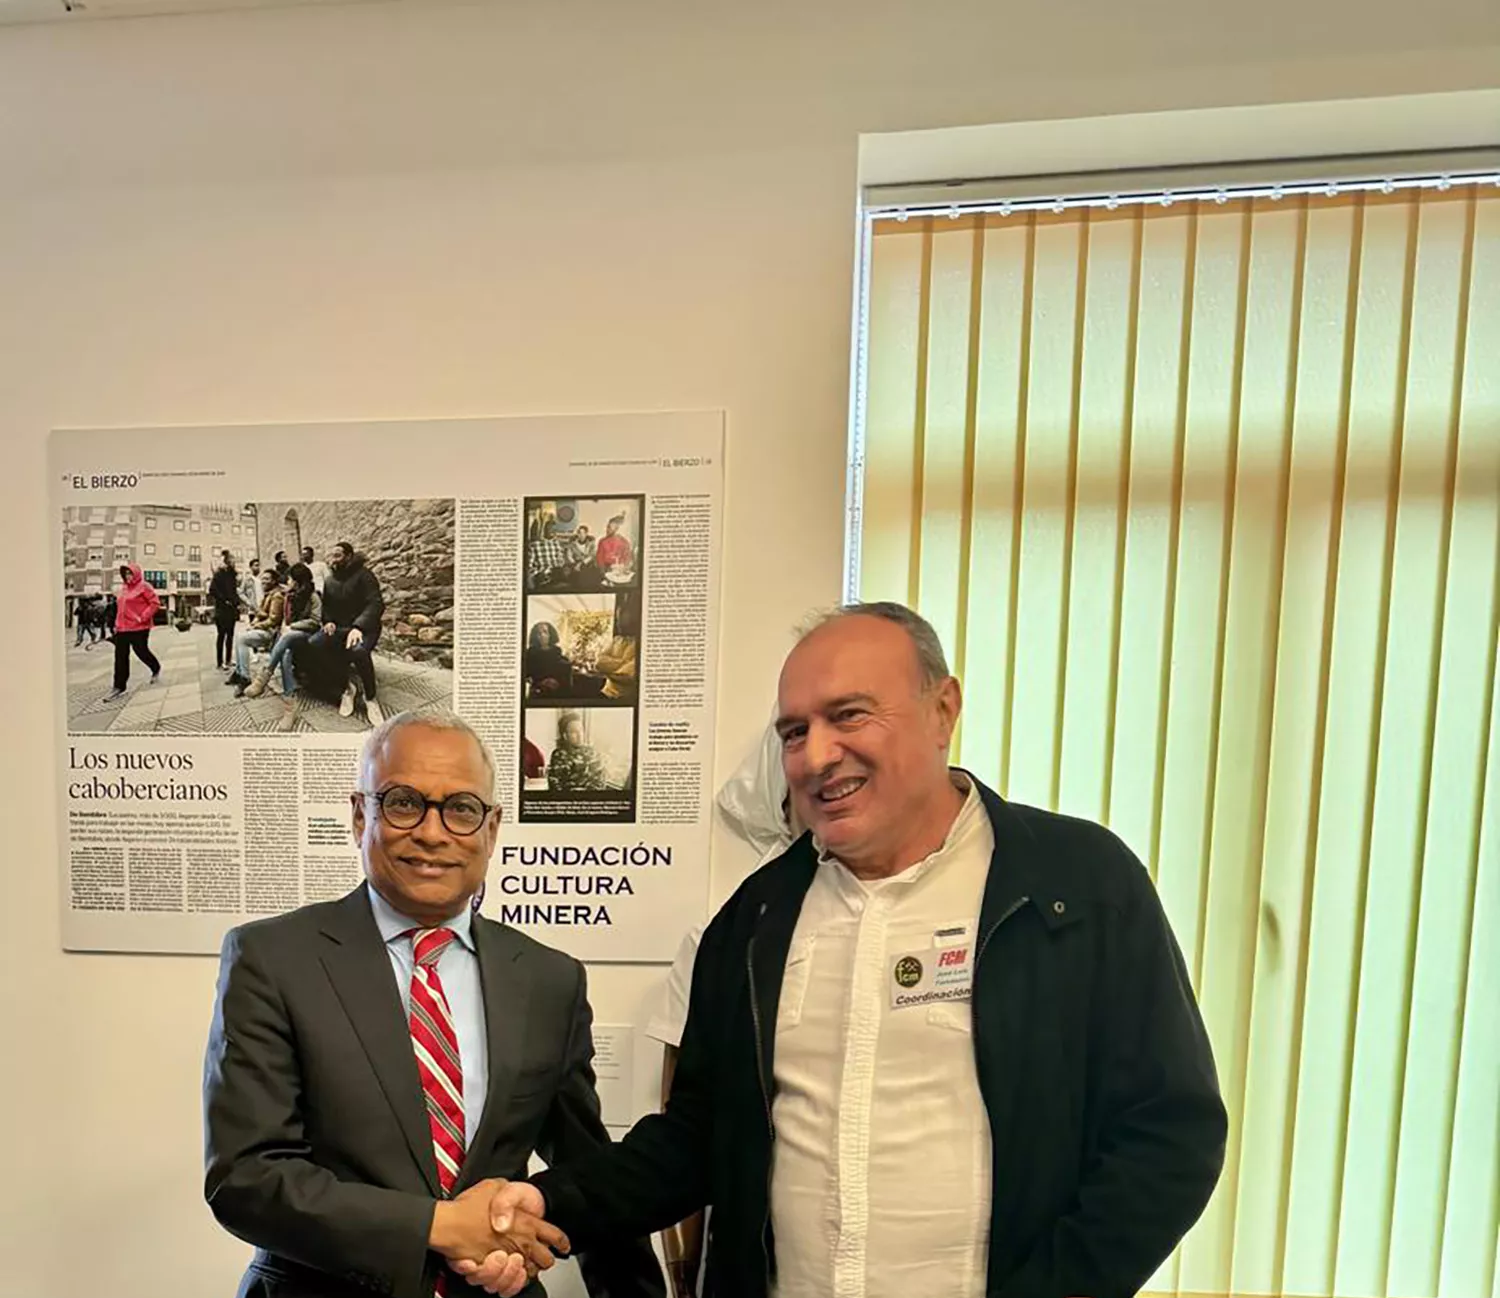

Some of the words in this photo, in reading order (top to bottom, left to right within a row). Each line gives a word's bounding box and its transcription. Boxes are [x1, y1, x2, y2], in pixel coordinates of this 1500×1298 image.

[73, 476, 88, 489] EL
[91, 475, 138, 489] BIERZO
[69, 747, 109, 770] Los
[115, 752, 194, 770] nuevos
[68, 776, 228, 801] cabobercianos
[501, 841, 672, 866] FUNDACIÓN
[500, 875, 634, 895] CULTURA
[501, 904, 612, 925] MINERA
[938, 948, 968, 967] FCM
